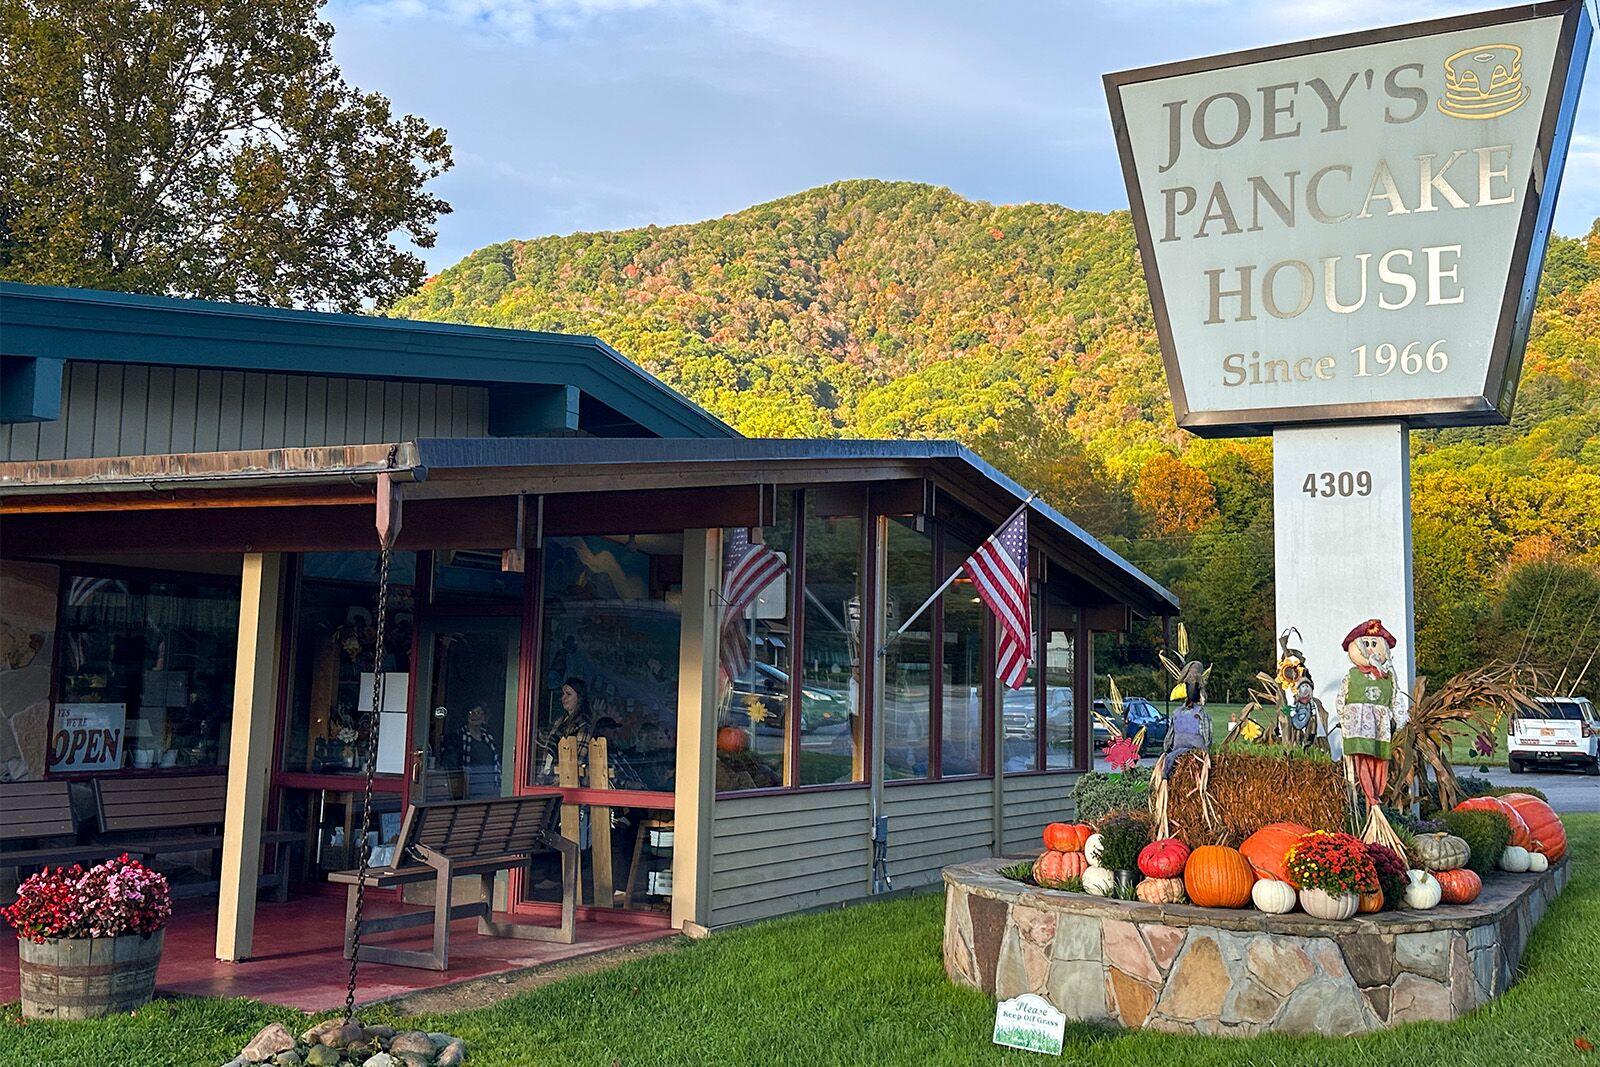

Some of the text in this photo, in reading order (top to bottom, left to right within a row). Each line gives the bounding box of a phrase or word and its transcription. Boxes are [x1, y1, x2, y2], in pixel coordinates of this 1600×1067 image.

[1158, 63, 1428, 173] JOEY'S
[1159, 144, 1516, 243] PANCAKE
[1203, 244, 1465, 325] HOUSE
[1223, 339, 1449, 387] Since 1966
[1302, 470, 1373, 498] 4309
[50, 728, 121, 766] OPEN
[1003, 1010, 1022, 1020] Keep
[1036, 1017, 1059, 1027] Grass
[1015, 1002, 1048, 1016] Please
